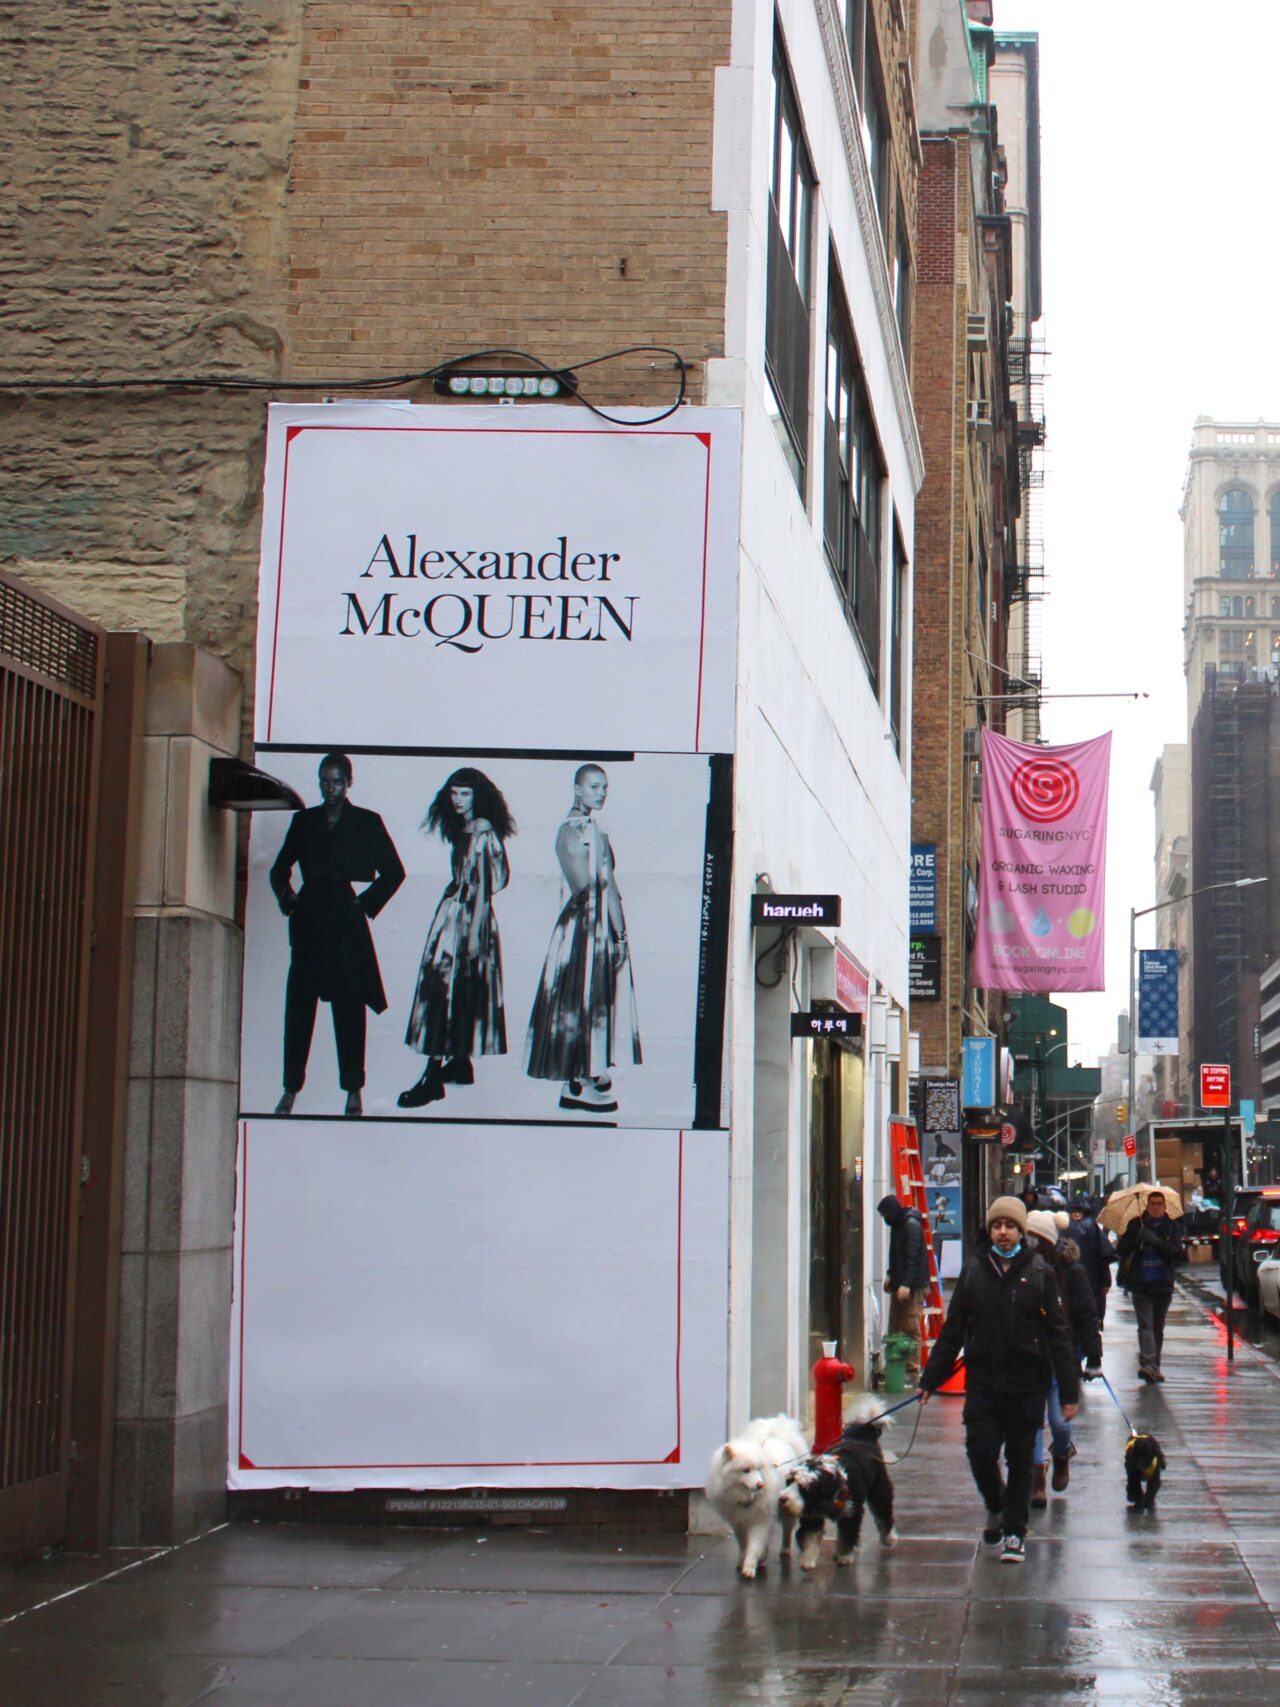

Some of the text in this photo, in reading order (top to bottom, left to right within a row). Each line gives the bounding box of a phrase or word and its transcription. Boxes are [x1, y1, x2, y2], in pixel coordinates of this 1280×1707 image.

[359, 533, 621, 582] Alexander
[339, 592, 641, 654] McQUEEN
[999, 827, 1090, 841] SUGARINGNYC
[991, 860, 1095, 875] ORGANIC WAXING
[1008, 881, 1037, 894] LASH
[1041, 884, 1087, 895] STUDIO
[763, 903, 824, 917] harueh
[993, 944, 1086, 960] BOOK ONLINE
[991, 963, 1088, 975] www.sugaringnyc.com
[974, 1052, 982, 1104] JUDAICA
[390, 1501, 427, 1510] PERMIT
